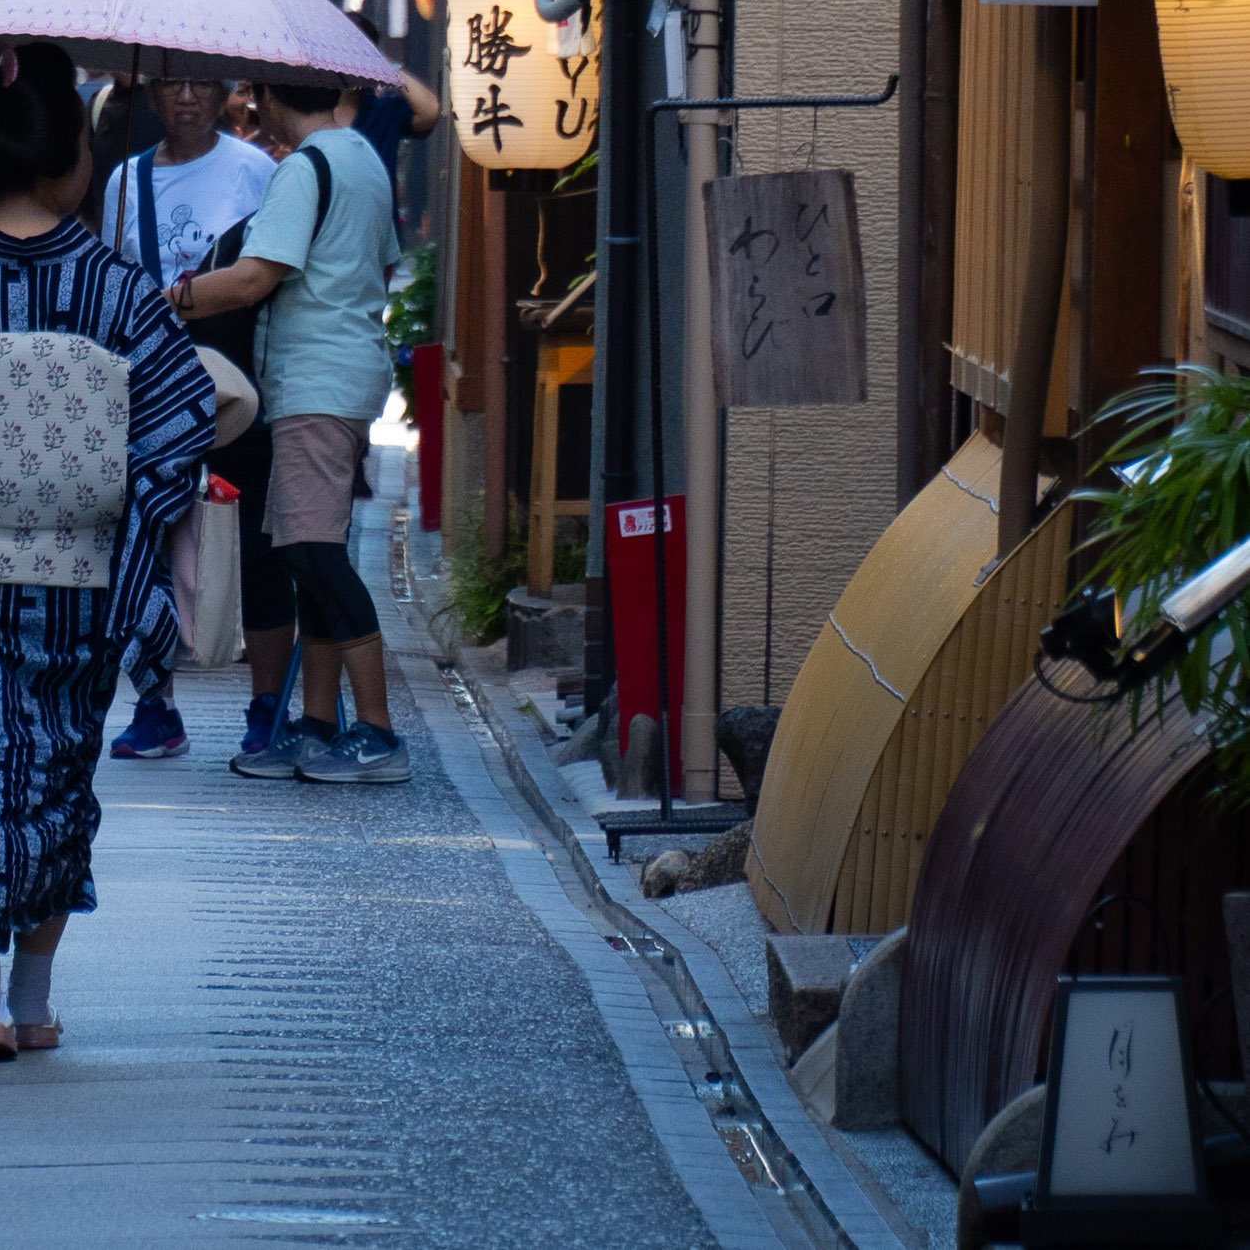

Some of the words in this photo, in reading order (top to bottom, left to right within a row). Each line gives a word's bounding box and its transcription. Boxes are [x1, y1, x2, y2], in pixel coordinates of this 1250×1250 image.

[554, 56, 589, 140] YU
[729, 215, 789, 360] わらび
